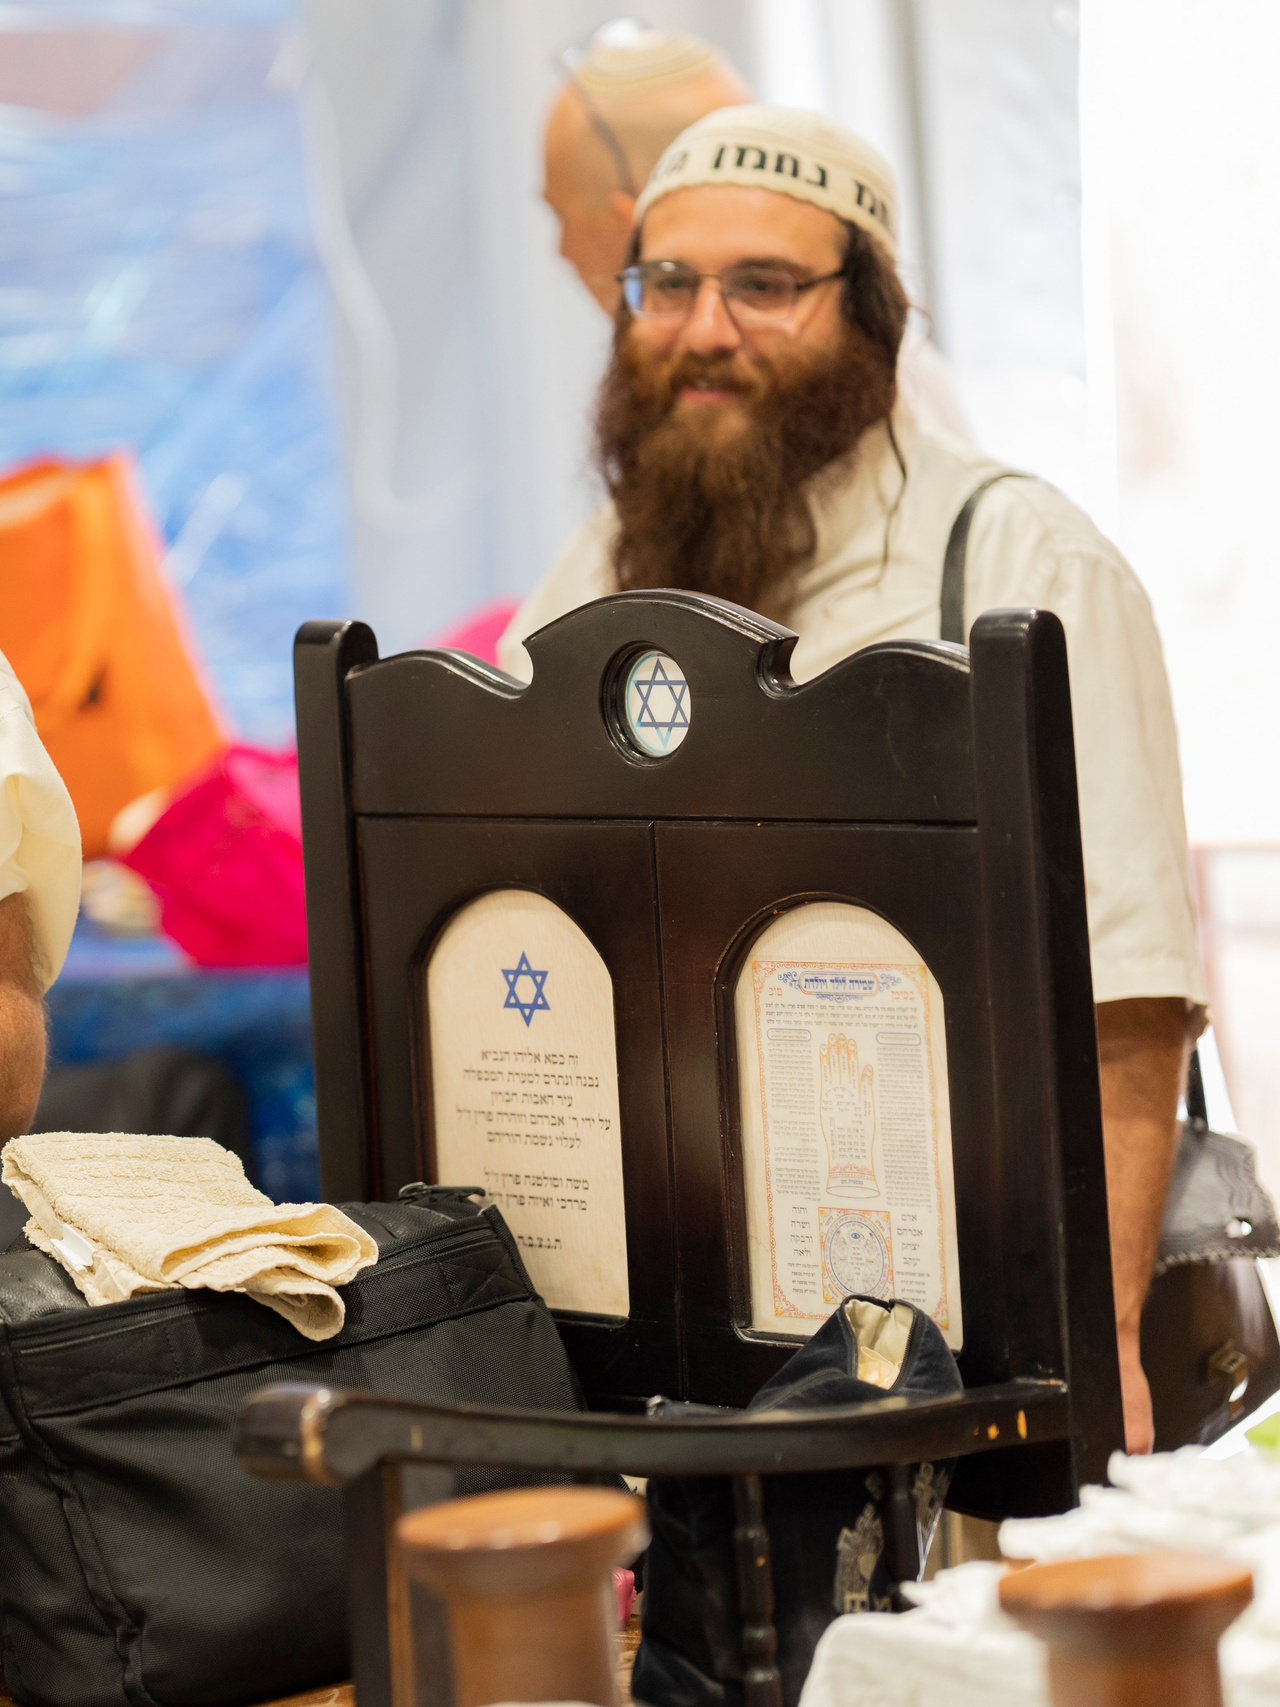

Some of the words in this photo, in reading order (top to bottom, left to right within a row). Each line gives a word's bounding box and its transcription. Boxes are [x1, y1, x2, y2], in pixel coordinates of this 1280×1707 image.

[713, 145, 827, 188] נחמן
[805, 976, 827, 990] ויולדת
[830, 976, 846, 990] לילד
[849, 979, 874, 990] שמירה
[481, 1050, 509, 1062] הנביא
[513, 1048, 542, 1064] אליהו
[544, 1054, 565, 1064] כסא
[568, 1054, 579, 1066] זה
[463, 1066, 503, 1081] המכפלה
[507, 1068, 539, 1084] למערת
[544, 1074, 572, 1086] ונתרם
[576, 1076, 599, 1088] נבנה
[491, 1091, 518, 1106] חברון
[522, 1094, 553, 1104] האבות
[557, 1095, 572, 1107] עיר
[474, 1110, 493, 1124] פרץ
[530, 1114, 564, 1126] אברהם
[582, 1118, 595, 1128] ידי
[598, 1114, 610, 1130] על
[487, 1131, 520, 1142] הוריהם
[524, 1134, 552, 1146] נשמת
[556, 1132, 581, 1148] לעלוי
[502, 1173, 520, 1187] פרץ
[524, 1170, 563, 1188] וסולטנה
[566, 1179, 589, 1190] משה
[506, 1194, 525, 1209] פרץ
[557, 1198, 588, 1210] מרדכי
[901, 1214, 917, 1222] אדם
[791, 1220, 810, 1229] ושרה
[897, 1228, 923, 1237] אברהם
[790, 1234, 813, 1244] ורבקה
[793, 1247, 812, 1257] ולאה
[901, 1242, 920, 1252] יצחק
[903, 1257, 920, 1267] יעקב
